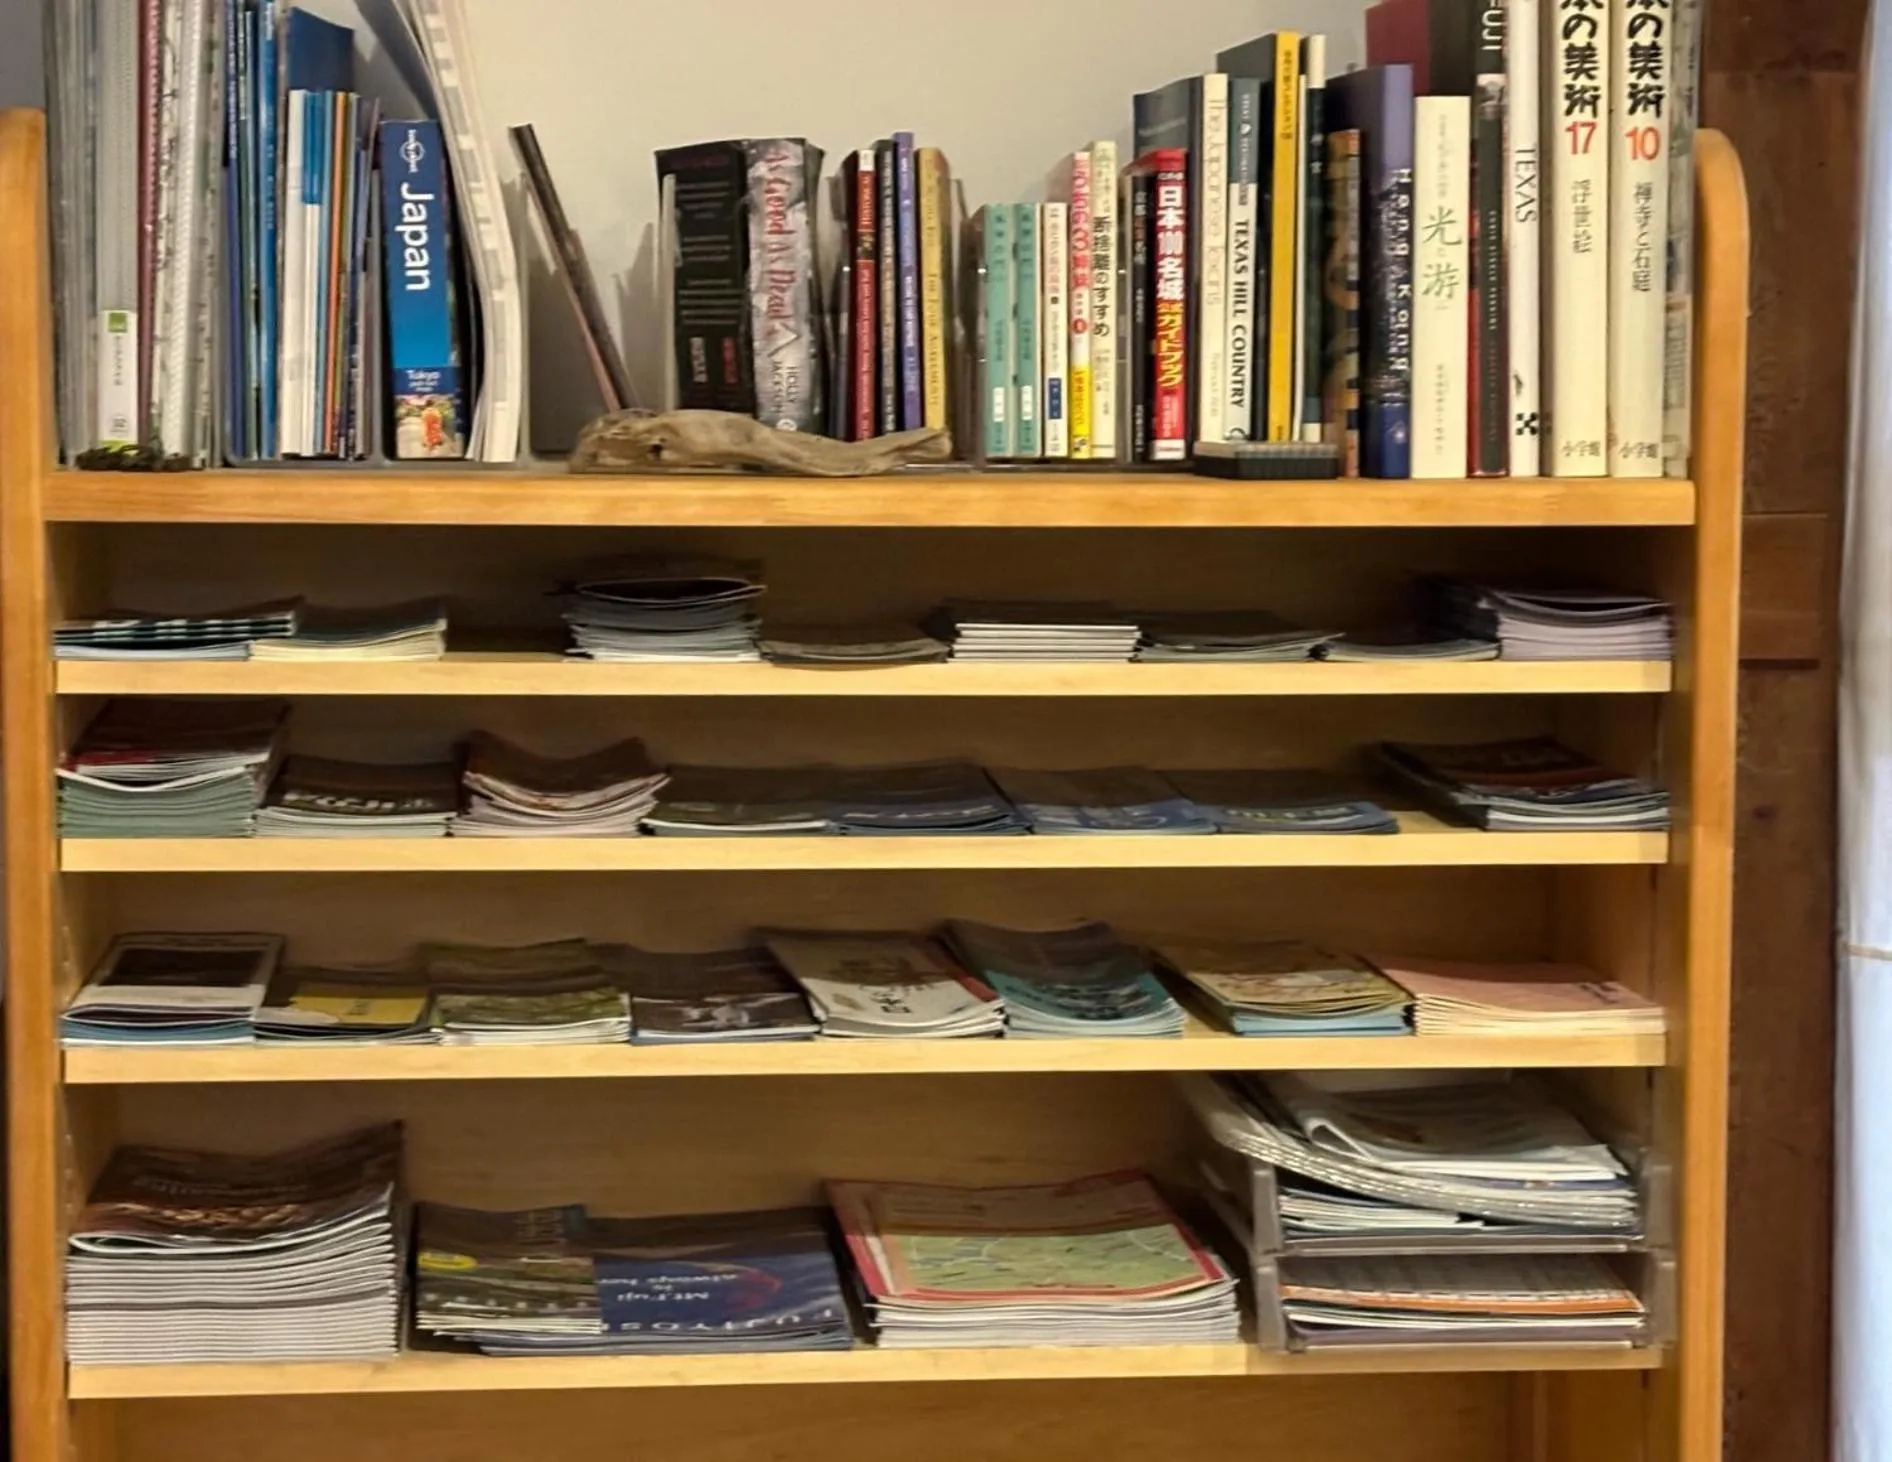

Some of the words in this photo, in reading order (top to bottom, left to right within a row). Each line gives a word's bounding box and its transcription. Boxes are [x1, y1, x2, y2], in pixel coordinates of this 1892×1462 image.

[1208, 97, 1225, 133] The
[1564, 121, 1599, 156] 17
[1624, 126, 1660, 161] 10
[766, 177, 797, 236] Good
[1204, 138, 1225, 238] Japanese
[1515, 146, 1537, 224] TEXAS
[394, 181, 436, 291] Japan
[1233, 219, 1250, 275] TEXAS
[1232, 281, 1249, 318] HILL
[1230, 324, 1248, 408] COUNTRY
